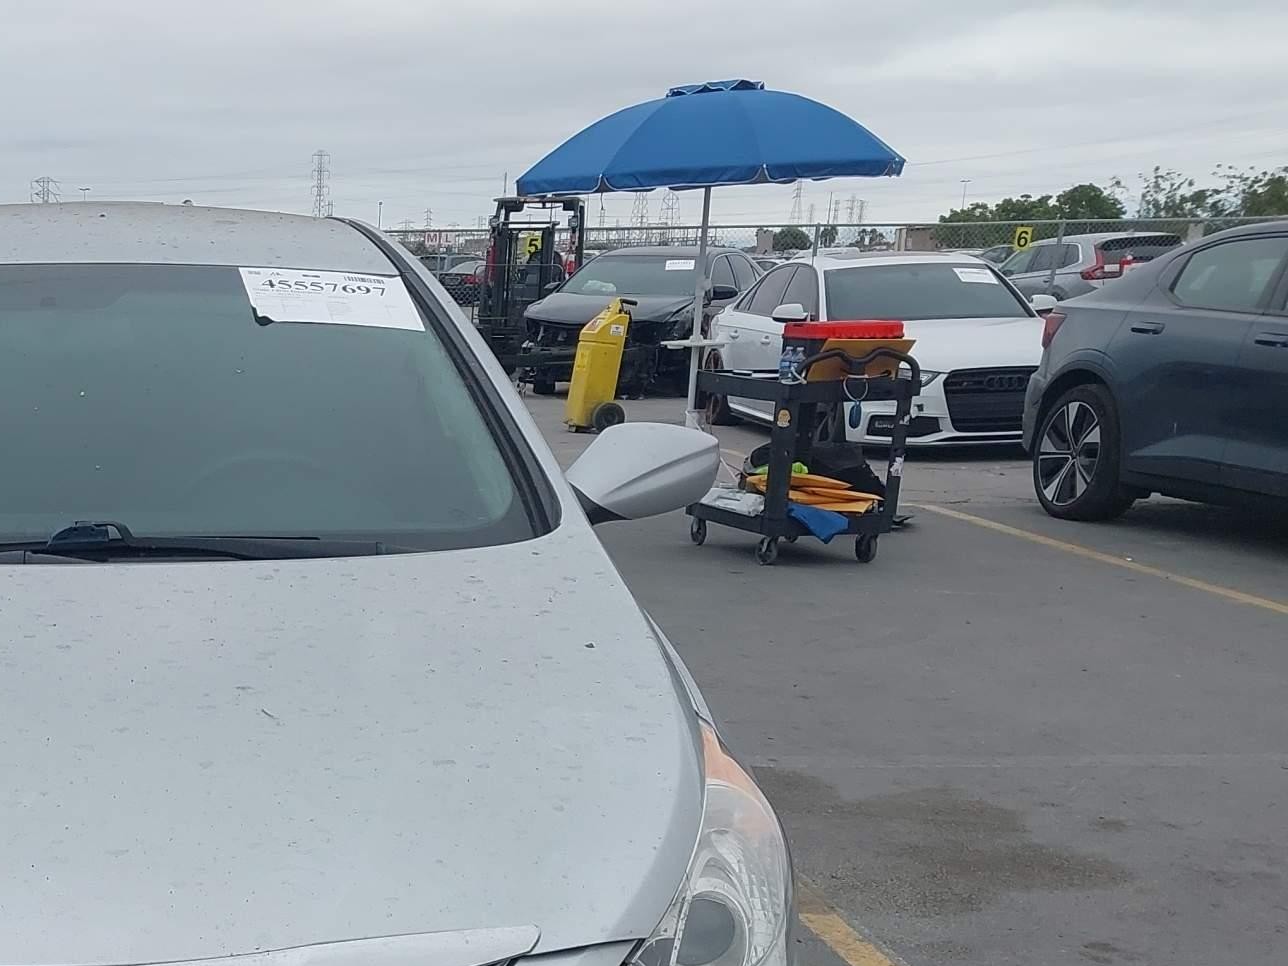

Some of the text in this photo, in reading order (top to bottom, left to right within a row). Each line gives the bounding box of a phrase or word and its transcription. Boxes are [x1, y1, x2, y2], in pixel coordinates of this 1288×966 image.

[427, 233, 437, 243] M
[527, 238, 539, 255] 5
[1016, 230, 1029, 248] 6
[261, 278, 386, 297] 45557697
